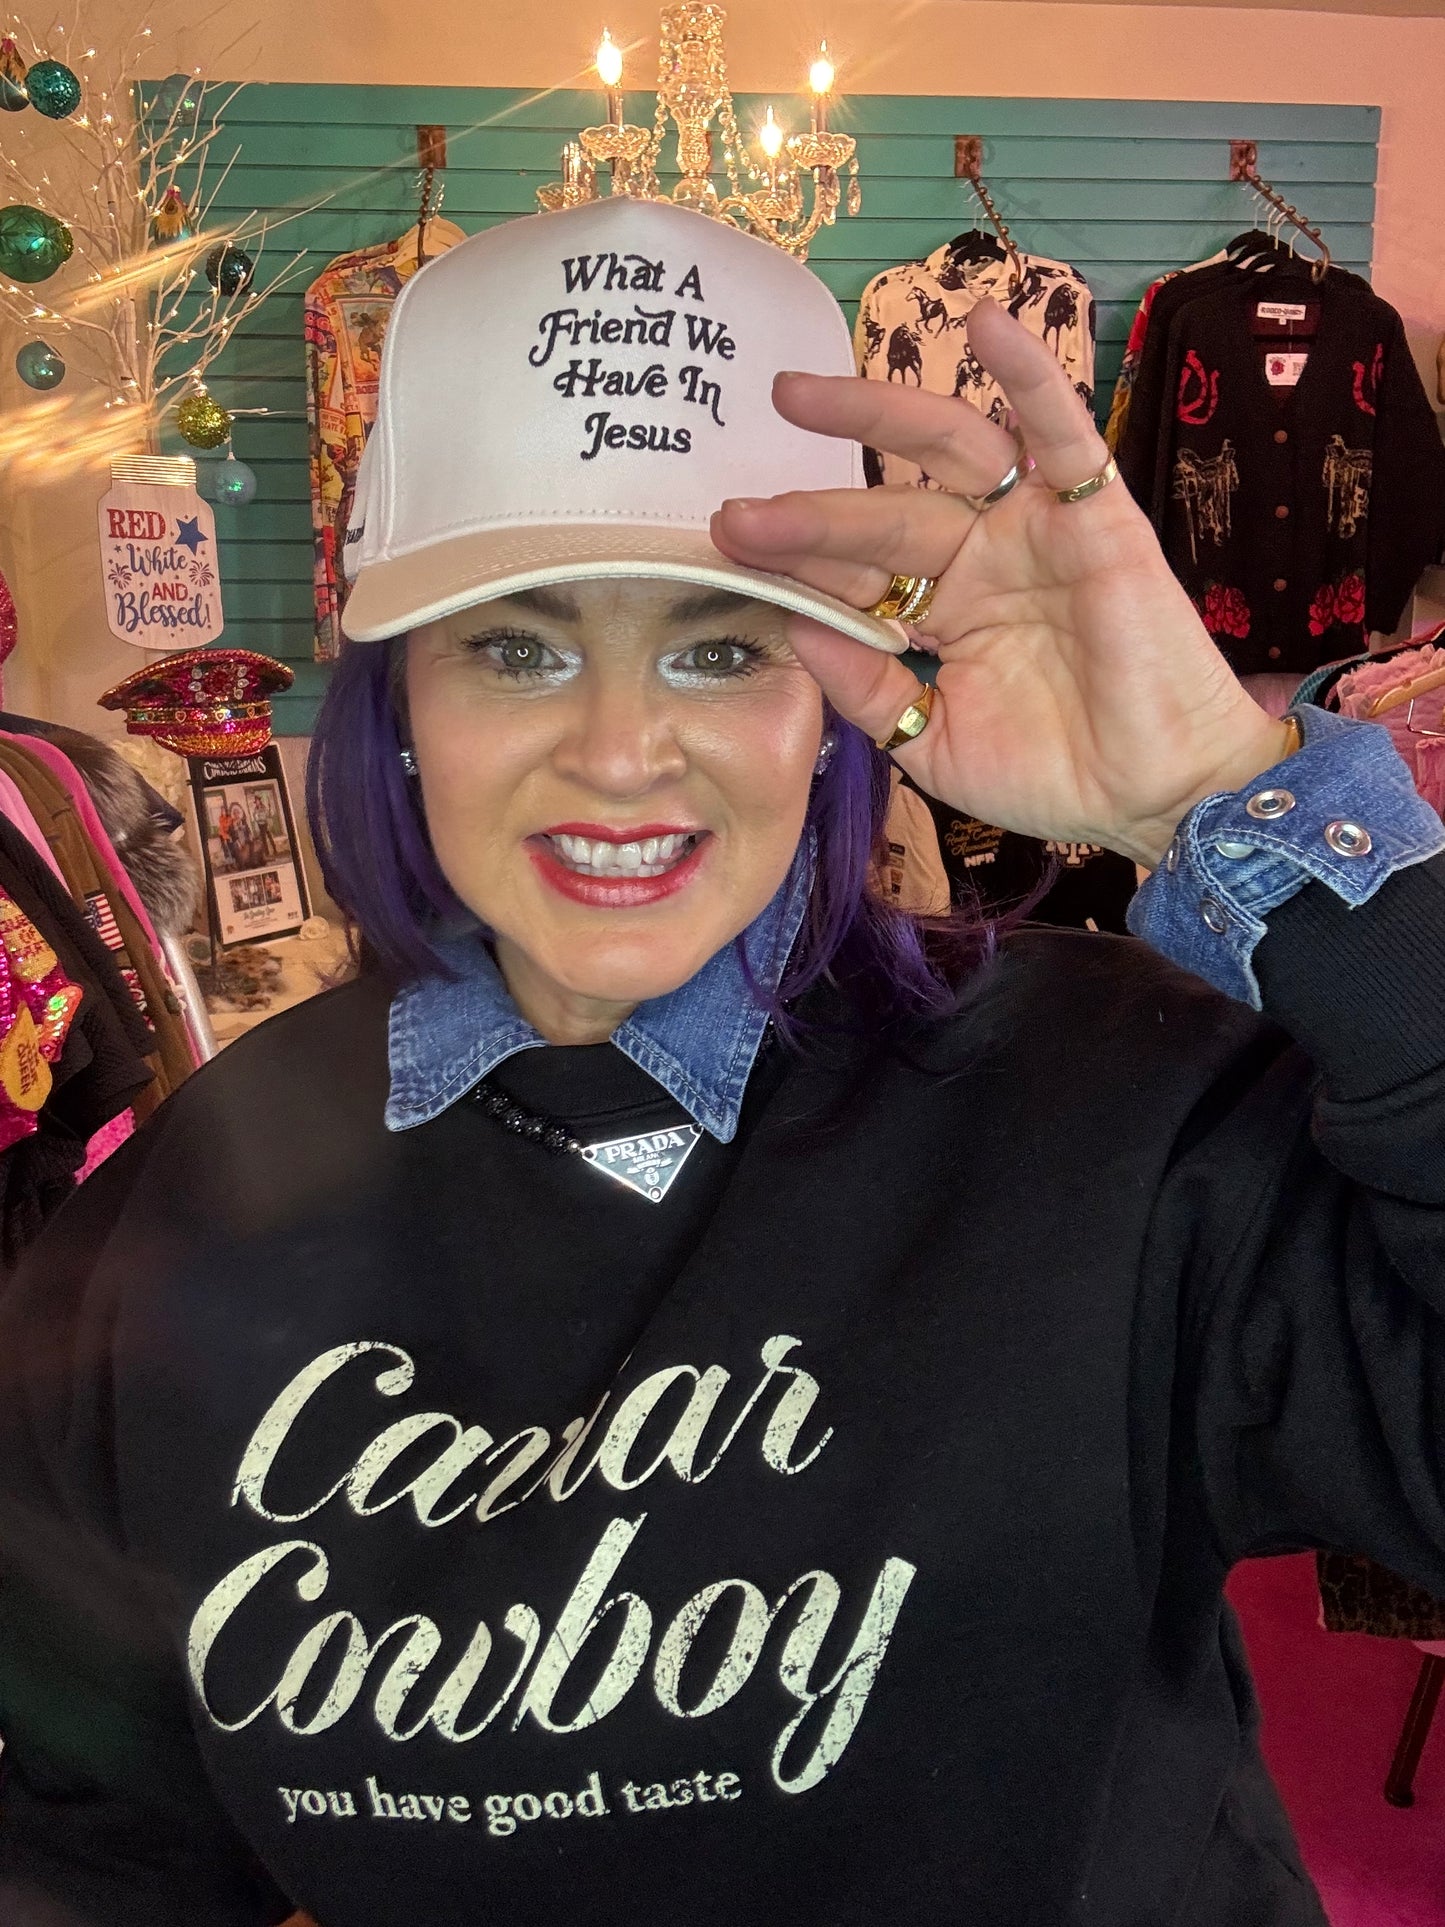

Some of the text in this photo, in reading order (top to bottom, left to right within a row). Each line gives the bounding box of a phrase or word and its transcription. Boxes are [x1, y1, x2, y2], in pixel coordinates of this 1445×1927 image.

[561, 252, 704, 302] What A
[528, 304, 736, 367] Friend We
[553, 358, 725, 427] Have In
[580, 411, 692, 460] Jesus
[106, 508, 166, 541] RED
[126, 543, 188, 576] White
[114, 591, 213, 632] Blessed!
[152, 582, 189, 601] AND
[604, 1131, 685, 1164] PRADA
[231, 1334, 834, 1527] Caviar
[188, 1512, 917, 1794] Cowboy
[278, 1768, 743, 1836] you have good taste
